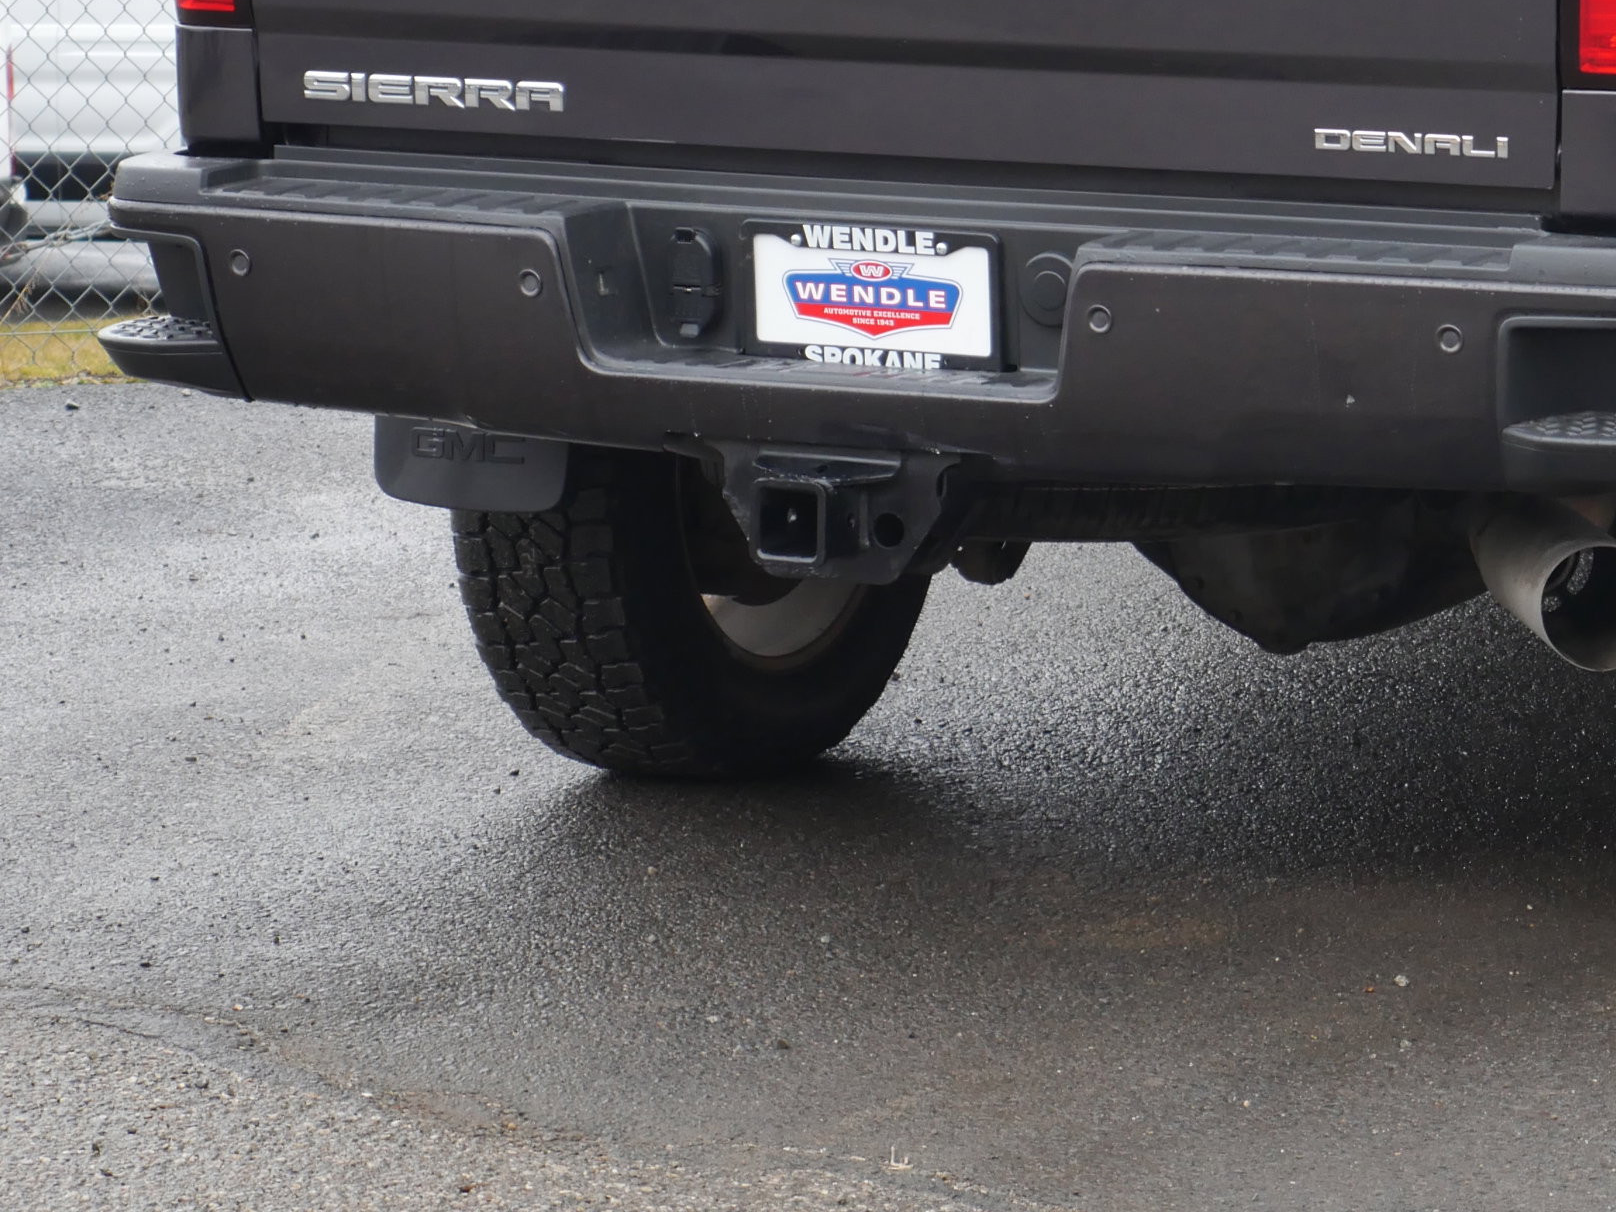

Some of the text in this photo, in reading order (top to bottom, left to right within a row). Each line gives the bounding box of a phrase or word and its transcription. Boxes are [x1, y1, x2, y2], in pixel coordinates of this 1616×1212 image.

[303, 70, 564, 113] SIERRA
[1314, 128, 1508, 159] DENALI
[802, 224, 936, 256] WENDLE
[795, 281, 946, 308] WENDLE
[823, 307, 920, 320] AUTOMOTIVE EXCELLENCE
[852, 317, 875, 326] SINCE
[804, 344, 942, 370] SPOKANE
[411, 426, 526, 465] GMC
